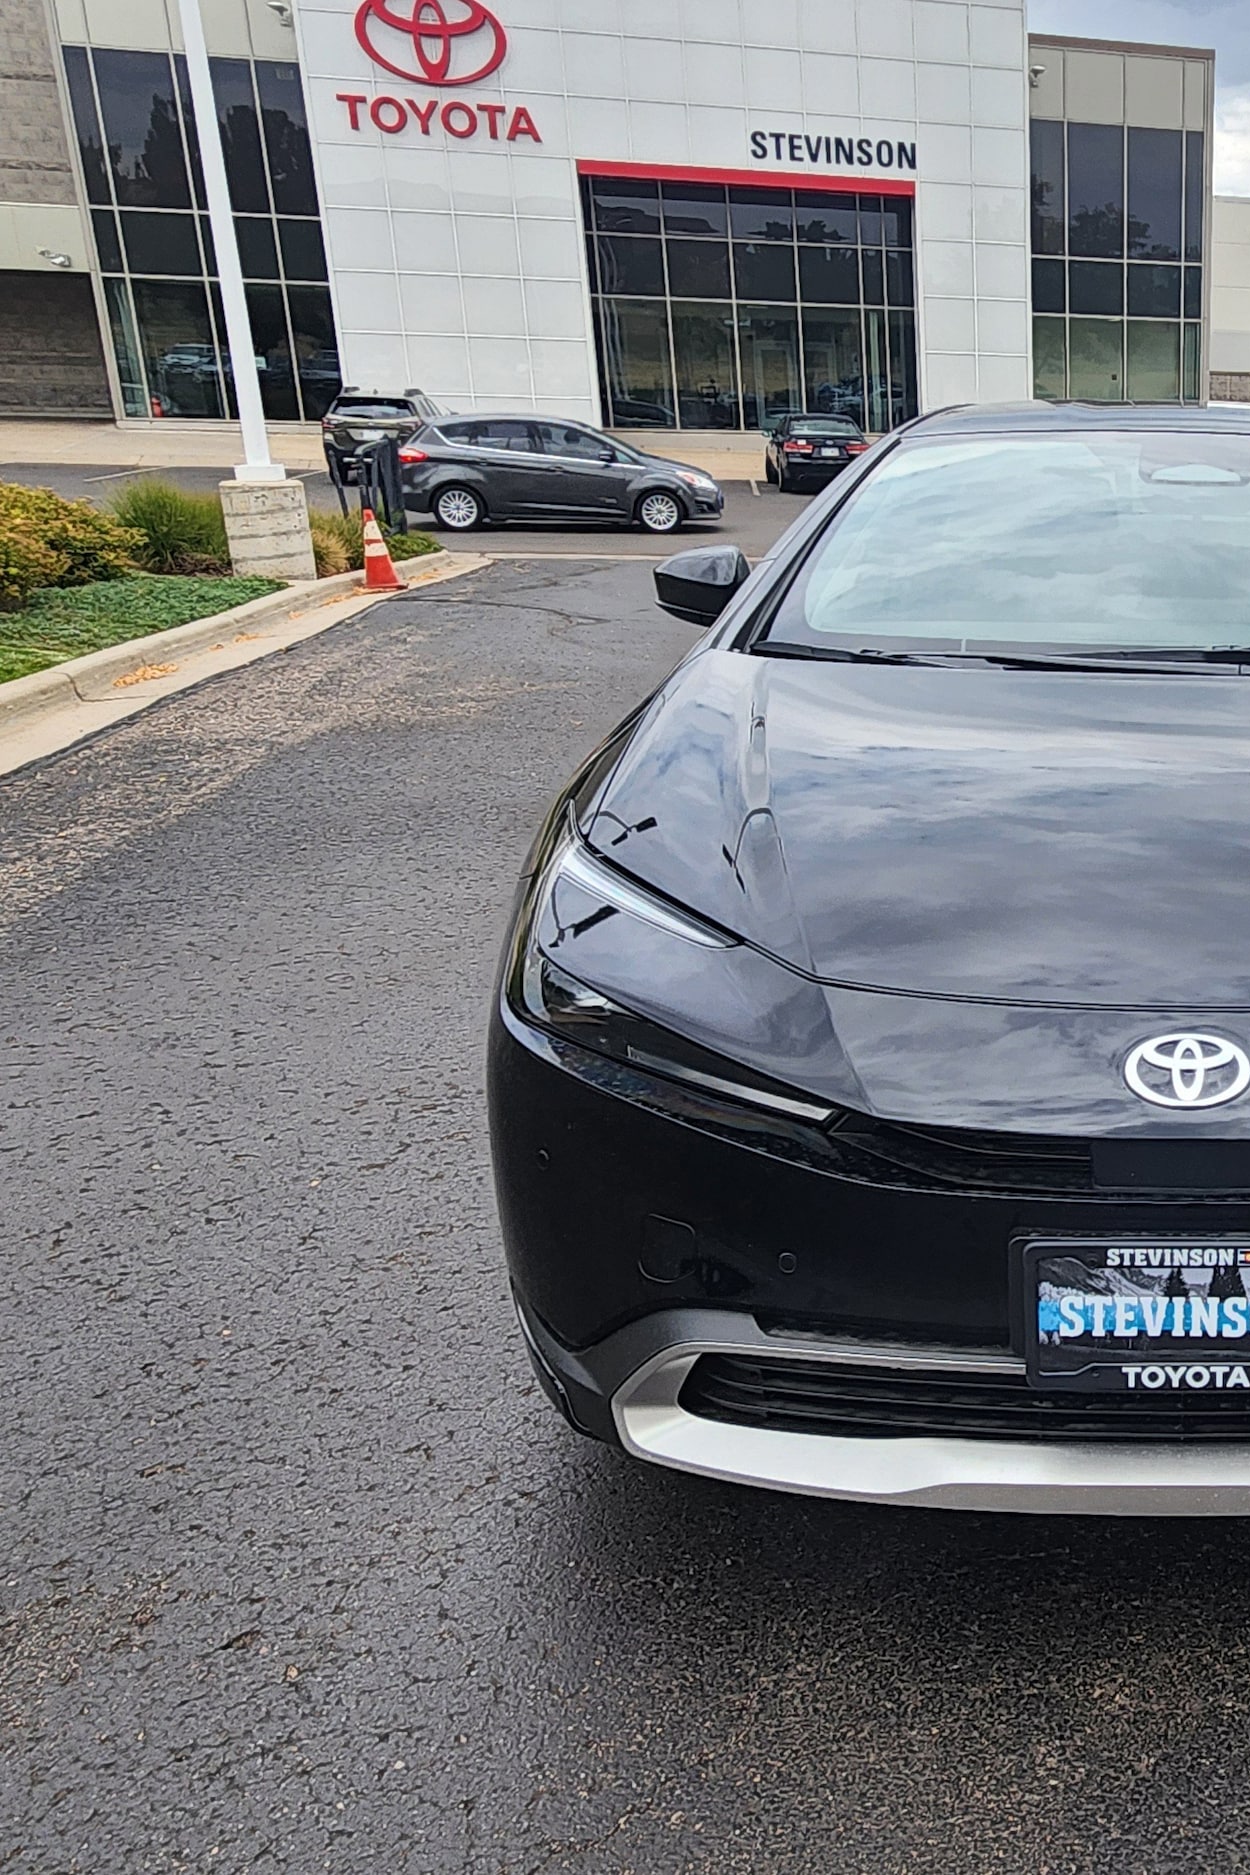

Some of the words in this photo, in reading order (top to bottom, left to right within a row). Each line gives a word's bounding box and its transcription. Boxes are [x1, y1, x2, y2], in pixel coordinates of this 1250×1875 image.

[336, 93, 543, 143] TOYOTA
[750, 131, 917, 170] STEVINSON
[1106, 1248, 1234, 1267] STEVINSON
[1121, 1365, 1250, 1389] TOYOTA
